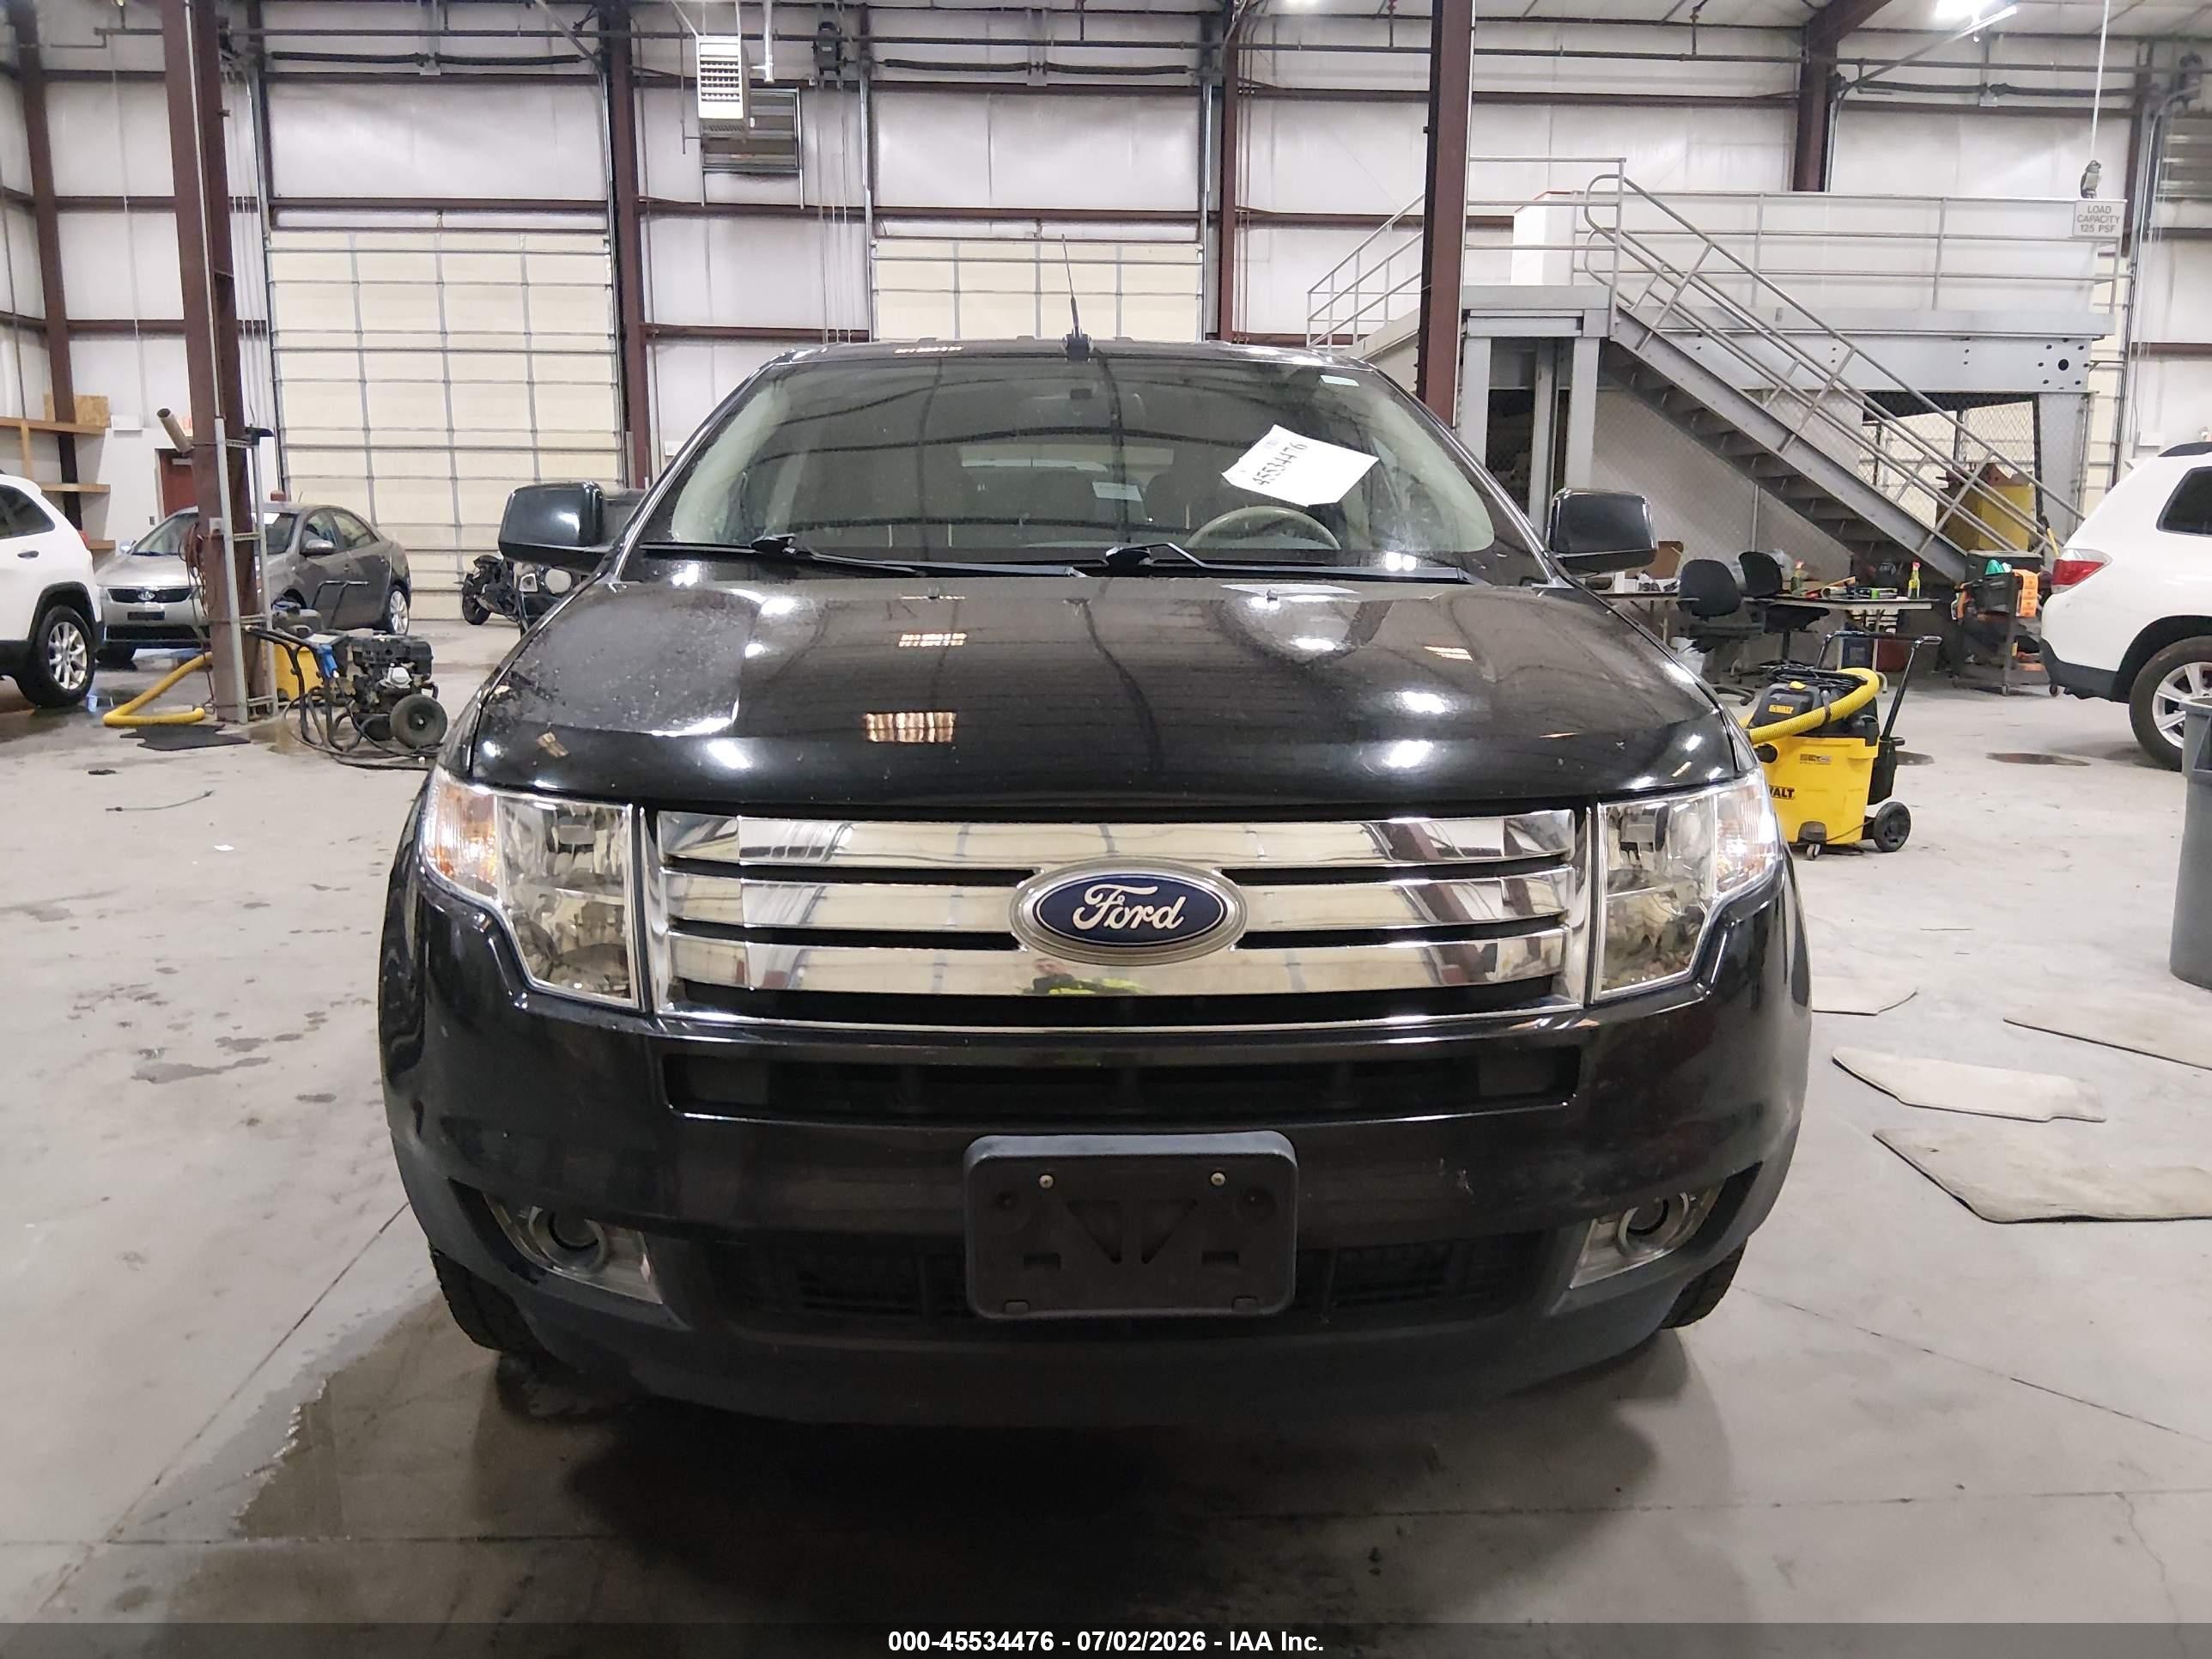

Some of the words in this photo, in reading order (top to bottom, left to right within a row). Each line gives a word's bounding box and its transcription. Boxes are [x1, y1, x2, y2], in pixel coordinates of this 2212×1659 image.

[2087, 205, 2112, 214] LOAD
[2077, 214, 2120, 223] CAPACITY
[2081, 224, 2095, 233] 125
[2098, 224, 2117, 233] PSF
[1253, 441, 1309, 485] 45534476
[1073, 884, 1187, 930] Ford
